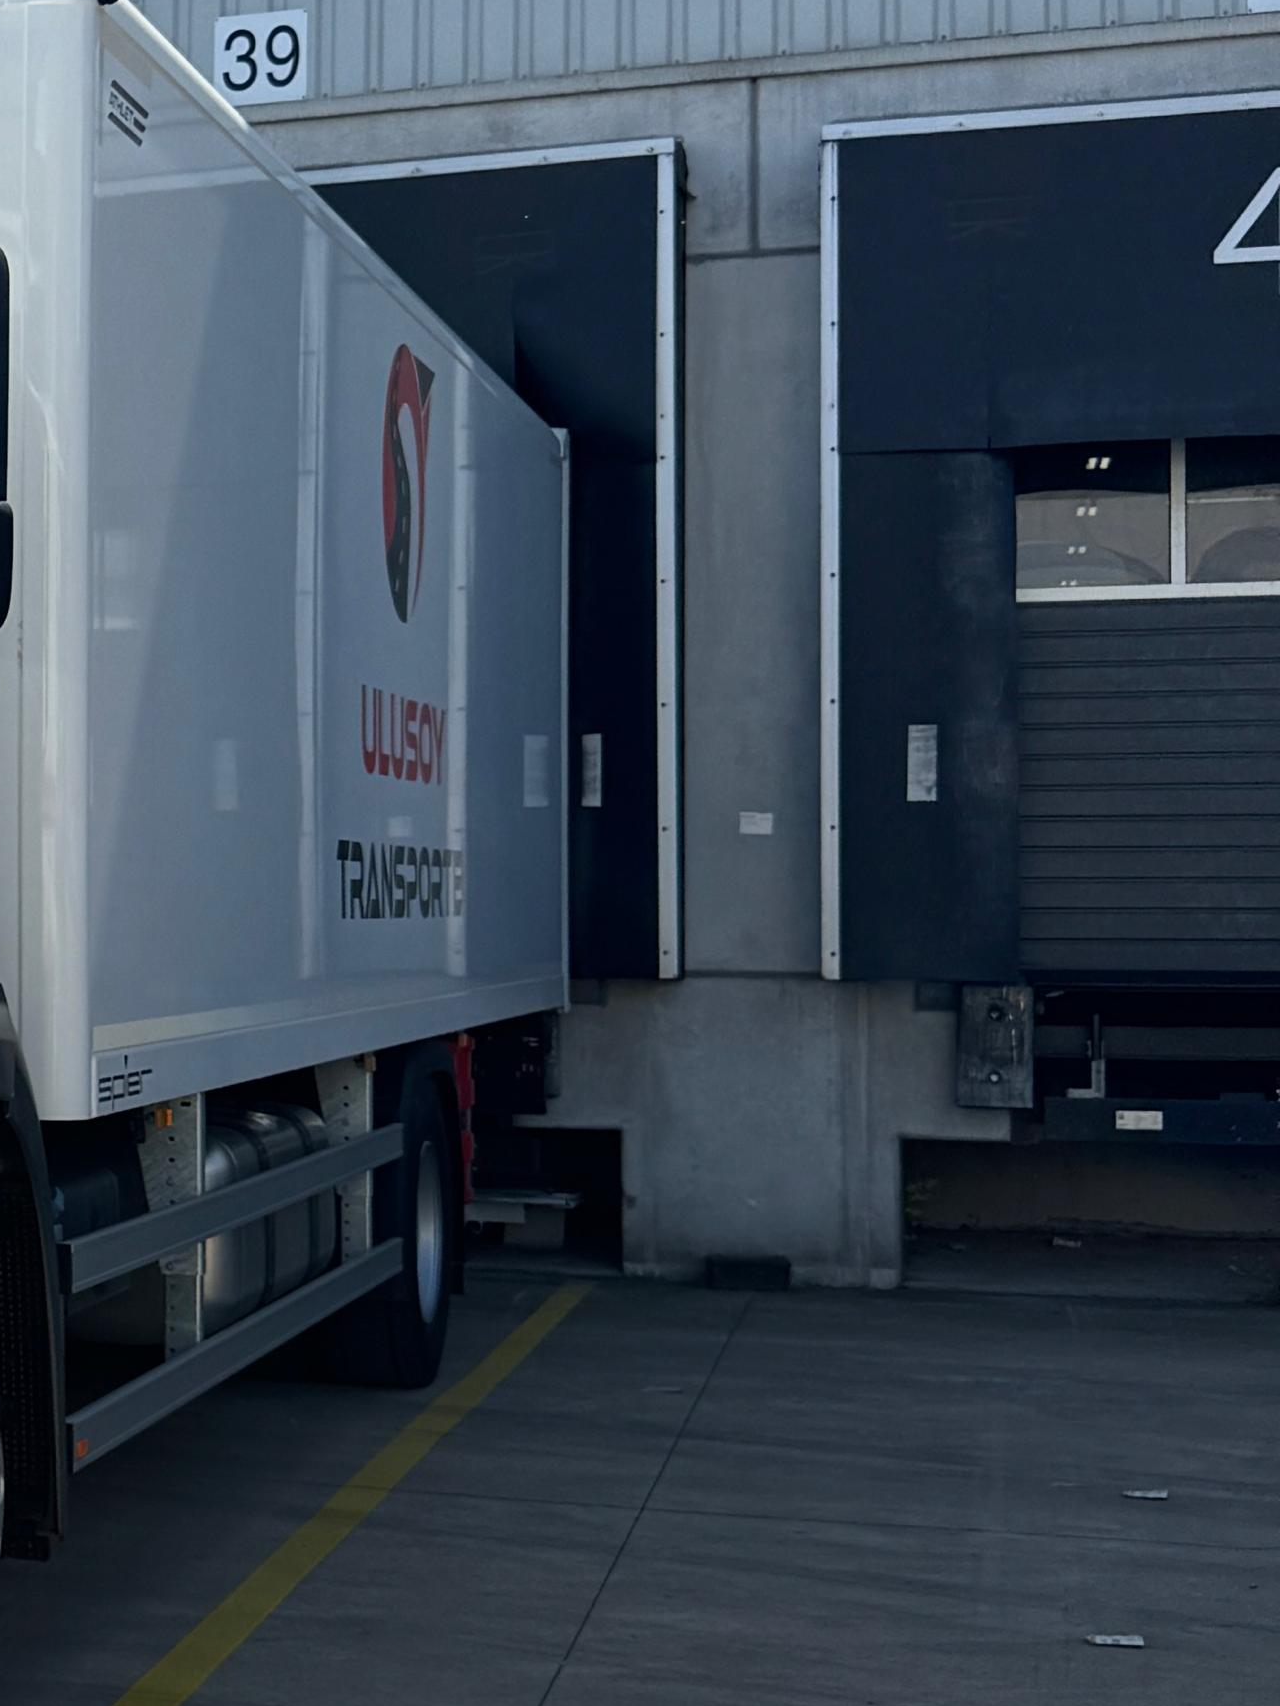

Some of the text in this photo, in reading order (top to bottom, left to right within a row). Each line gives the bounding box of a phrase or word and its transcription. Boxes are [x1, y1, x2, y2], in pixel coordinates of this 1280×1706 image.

[222, 24, 300, 92] 39
[361, 684, 447, 786] ULUSOY
[337, 840, 463, 920] TRANSPORTE
